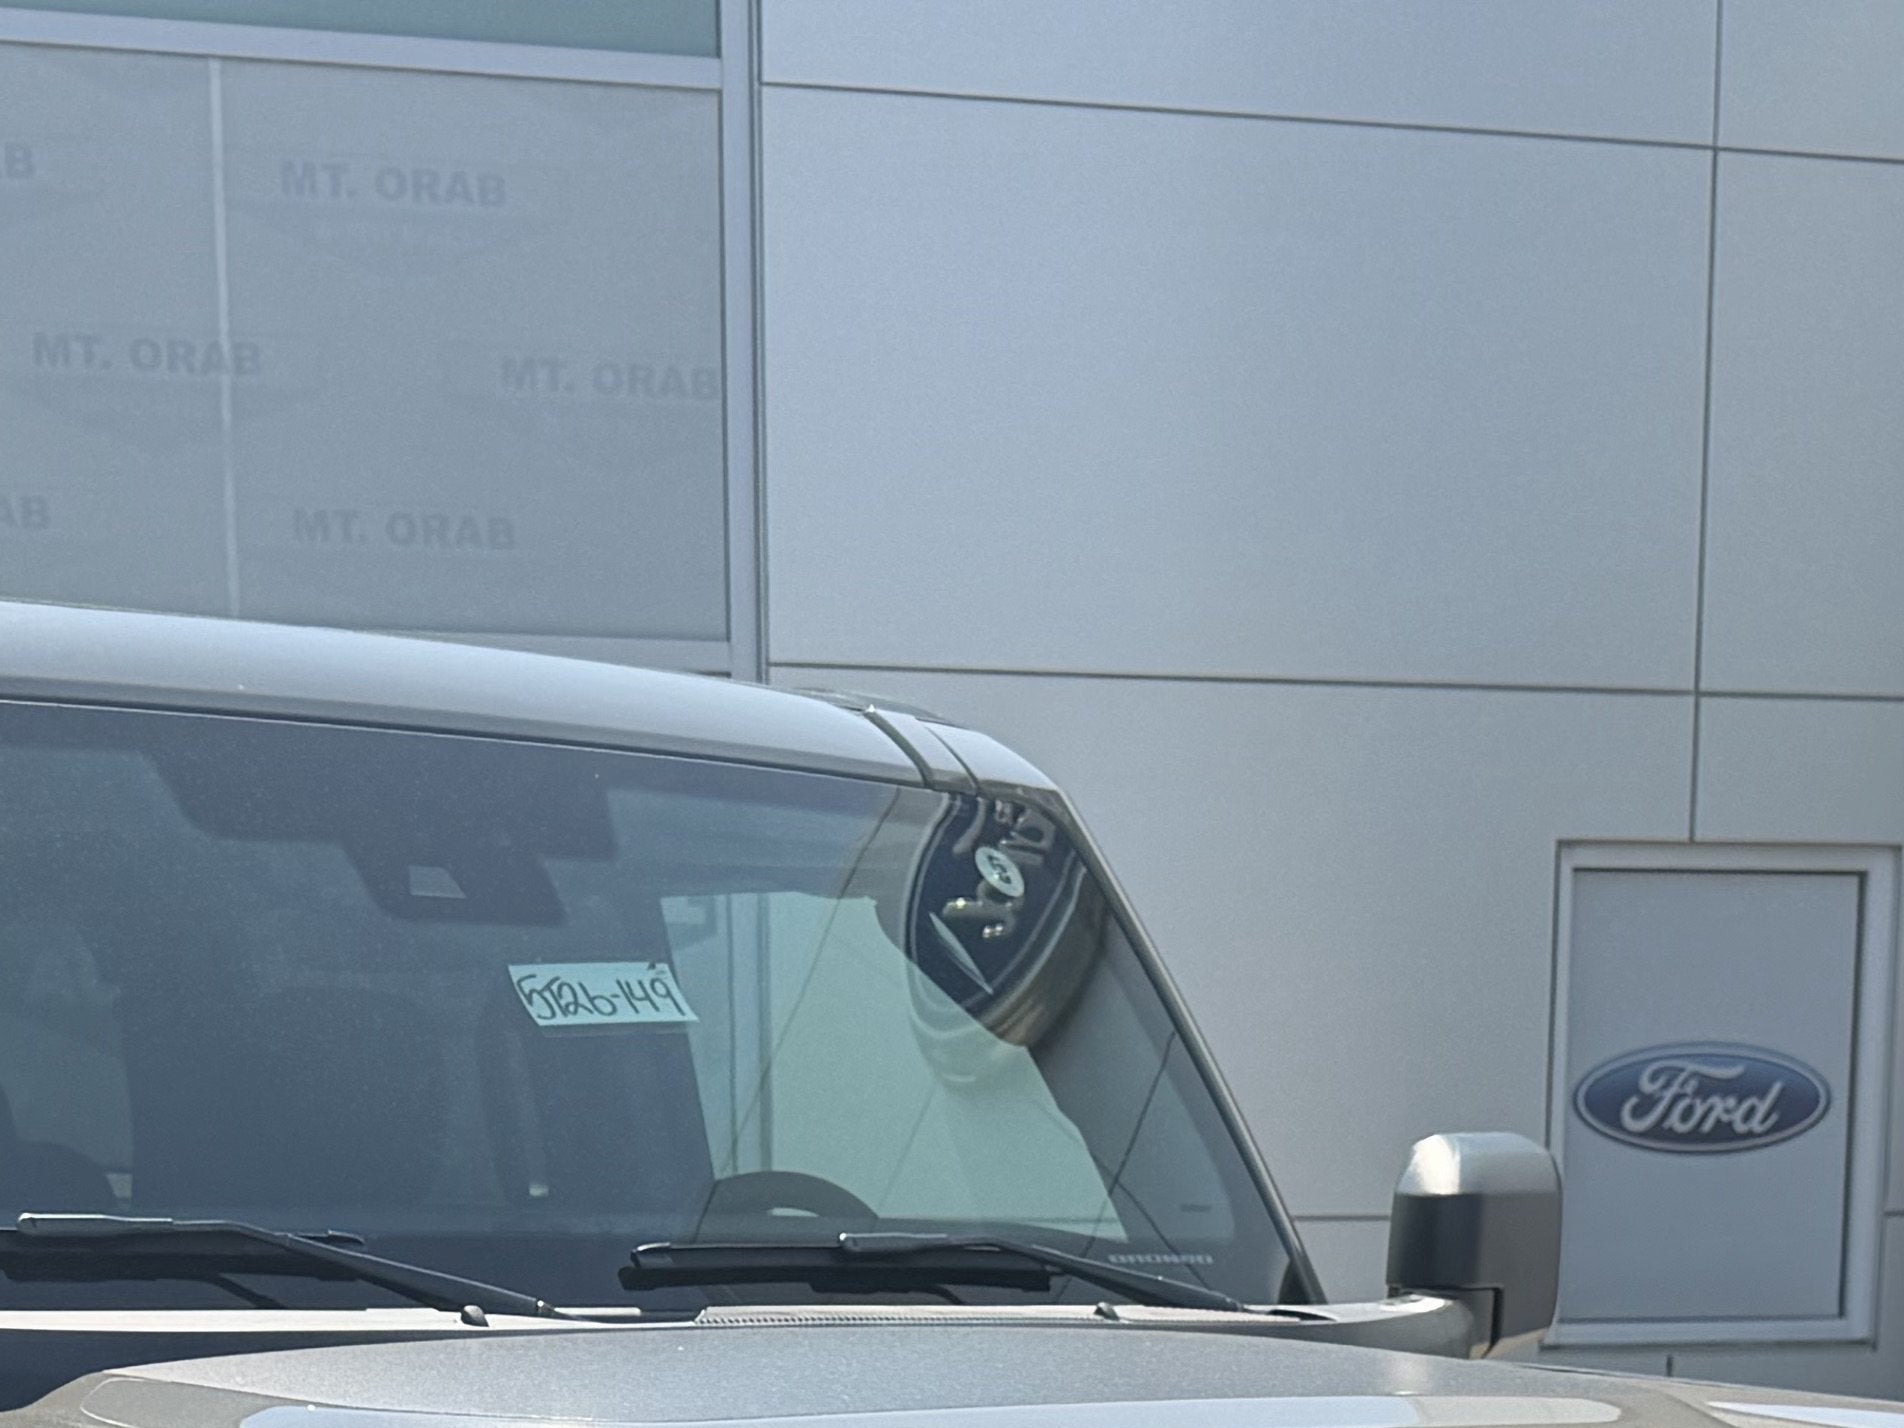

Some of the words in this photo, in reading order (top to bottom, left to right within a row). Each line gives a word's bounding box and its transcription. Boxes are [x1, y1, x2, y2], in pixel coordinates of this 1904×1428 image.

[280, 160, 357, 200] MT.
[375, 165, 507, 207] ORAB
[32, 332, 113, 371] MT.
[128, 337, 263, 377] ORAB
[501, 356, 574, 394] MT.
[591, 361, 720, 400] ORAB
[292, 506, 368, 545] MT.
[384, 511, 517, 551] ORAB
[1620, 1059, 1784, 1135] Ford
